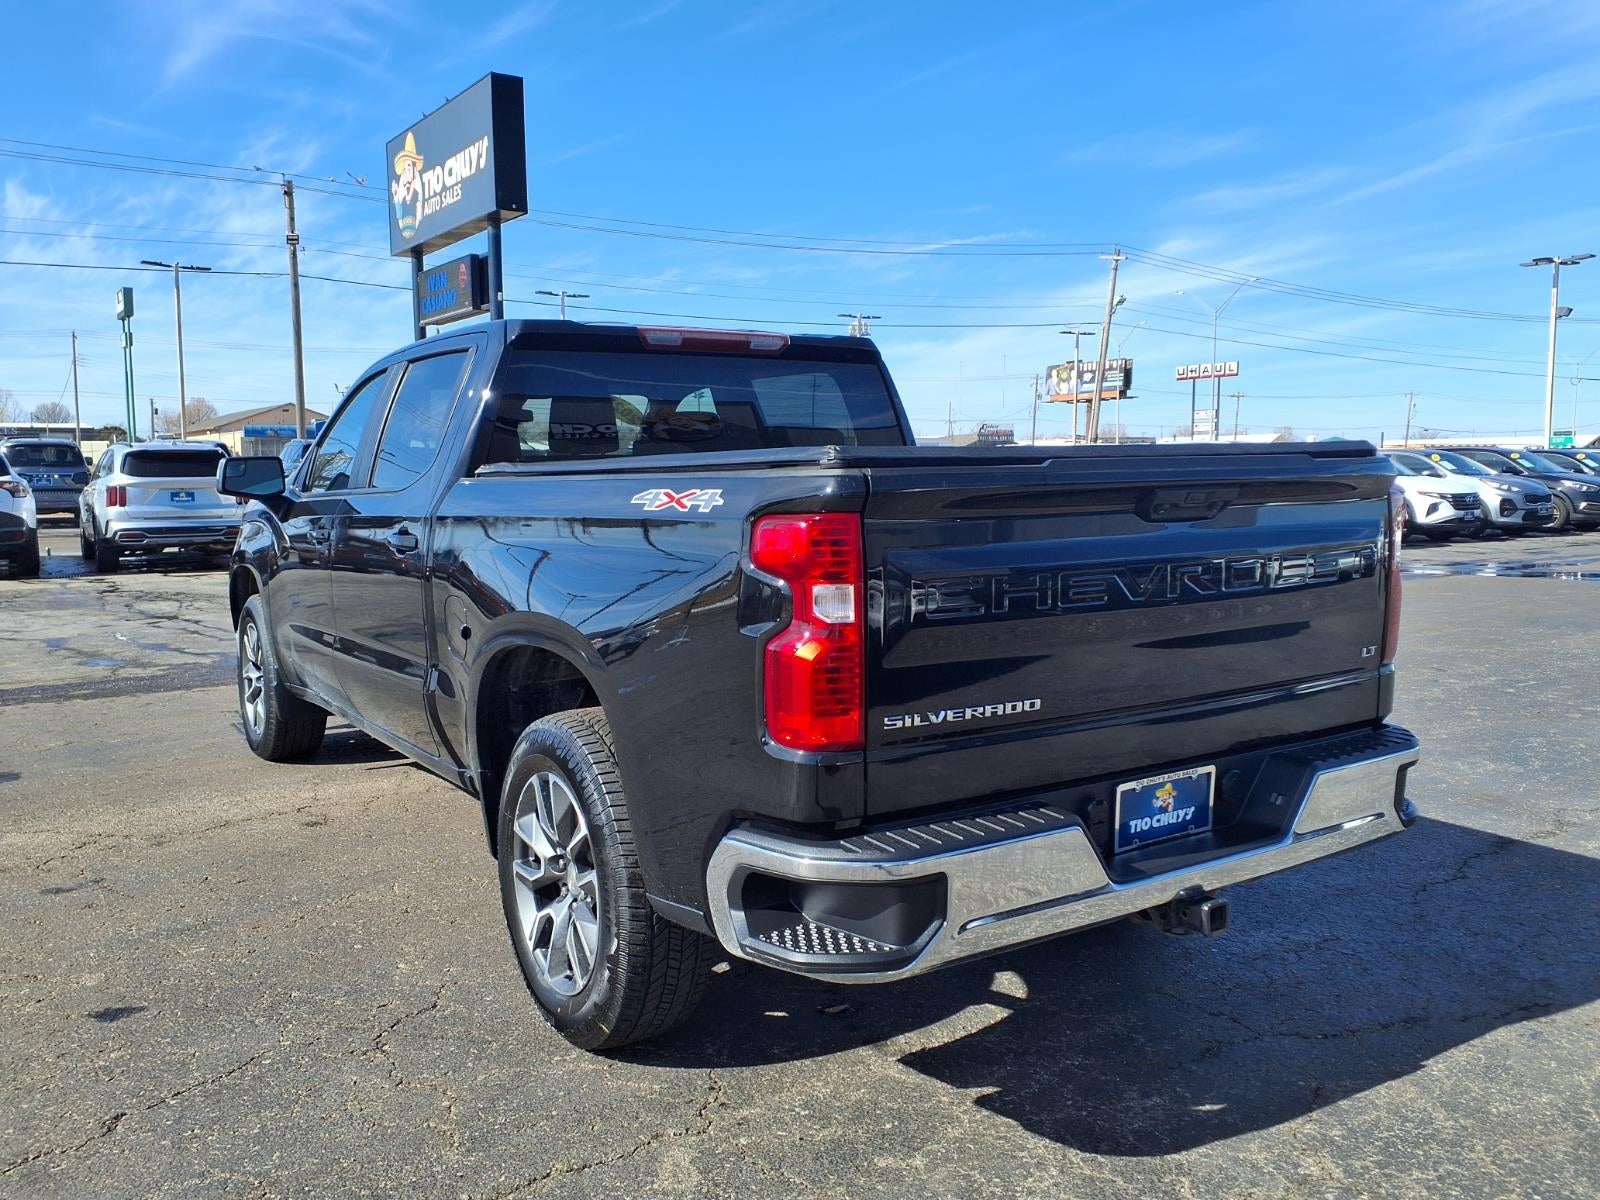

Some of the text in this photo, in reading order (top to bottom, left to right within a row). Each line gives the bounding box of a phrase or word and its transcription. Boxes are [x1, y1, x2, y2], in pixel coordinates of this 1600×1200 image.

[422, 135, 489, 199] TIO CHUY'S
[424, 183, 462, 217] AUTO SALES
[922, 547, 1379, 619] CHEVROLET
[1360, 645, 1377, 657] LT
[883, 697, 1042, 730] SILVERADO
[1167, 772, 1181, 780] AUTO
[1129, 816, 1152, 834] TIO
